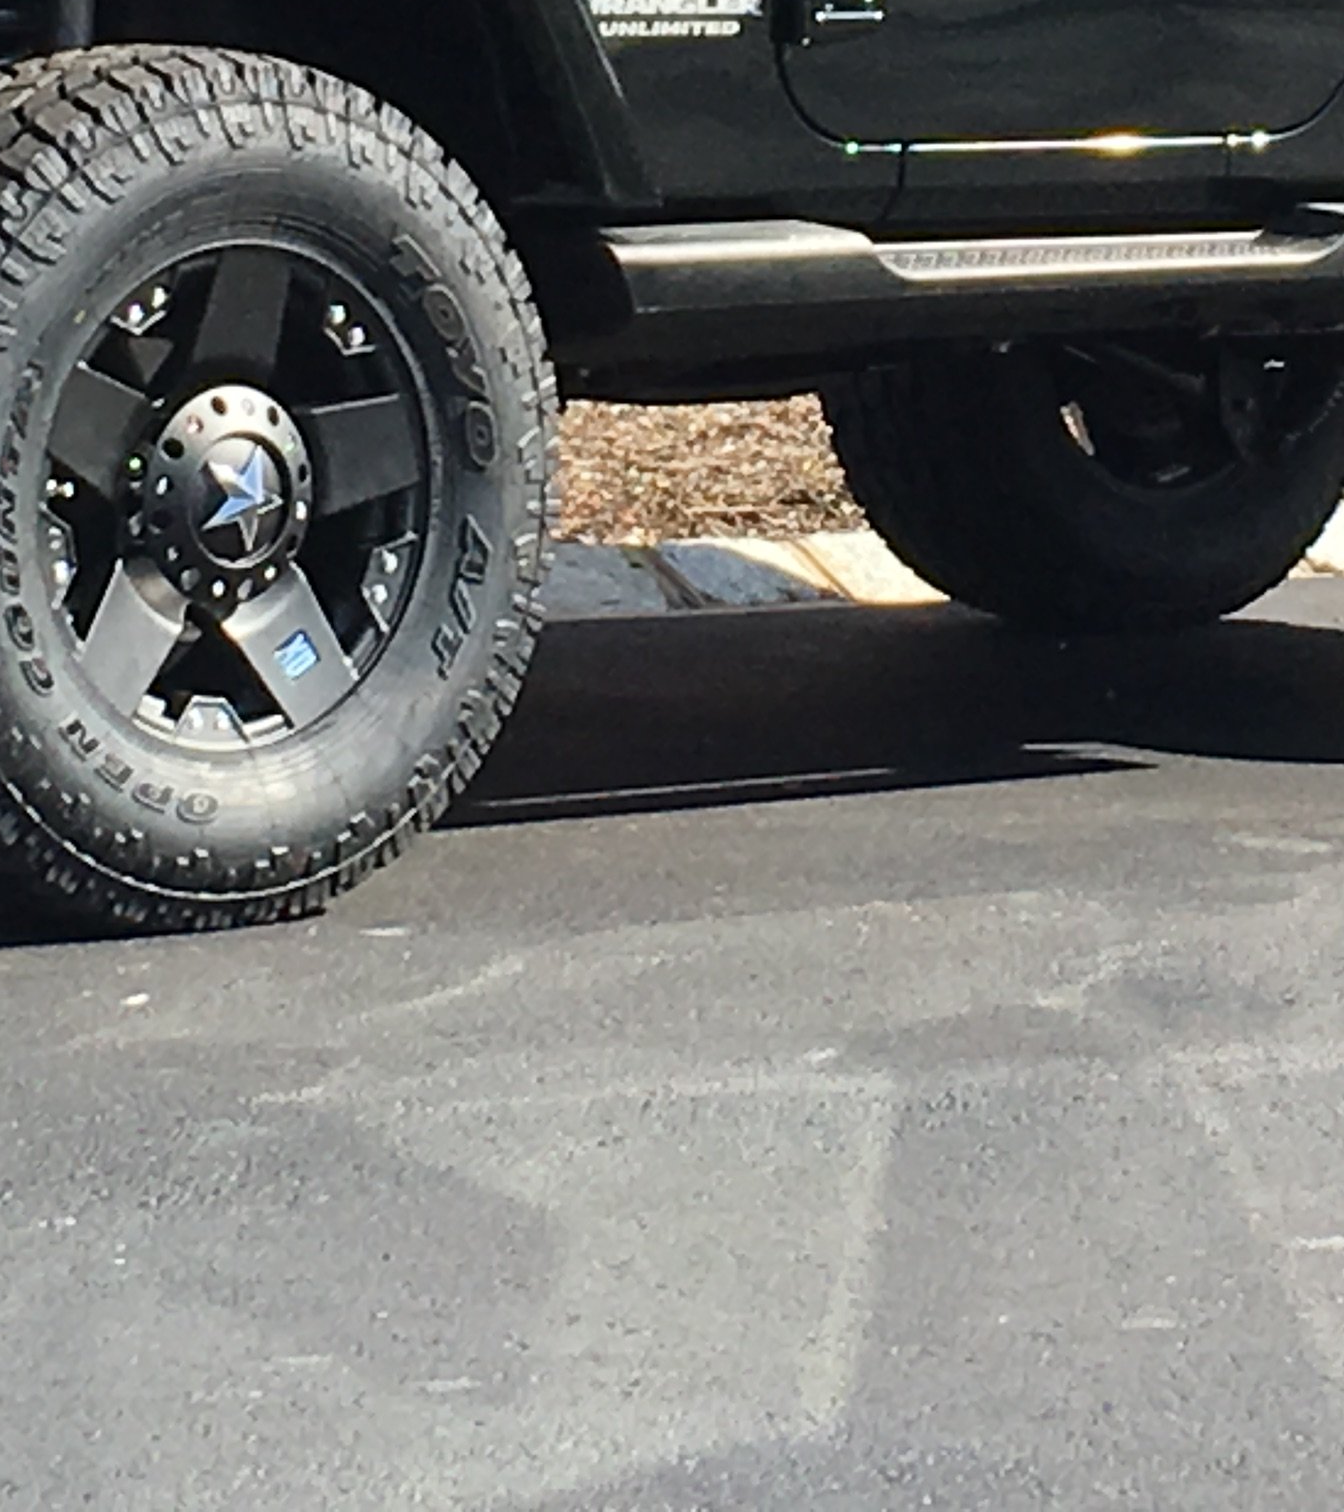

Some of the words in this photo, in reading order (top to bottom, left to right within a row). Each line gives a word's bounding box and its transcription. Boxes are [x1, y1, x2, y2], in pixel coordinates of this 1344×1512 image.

[598, 20, 741, 38] UNLIMITED
[389, 233, 498, 471] TOYO
[60, 716, 219, 824] OPEN
